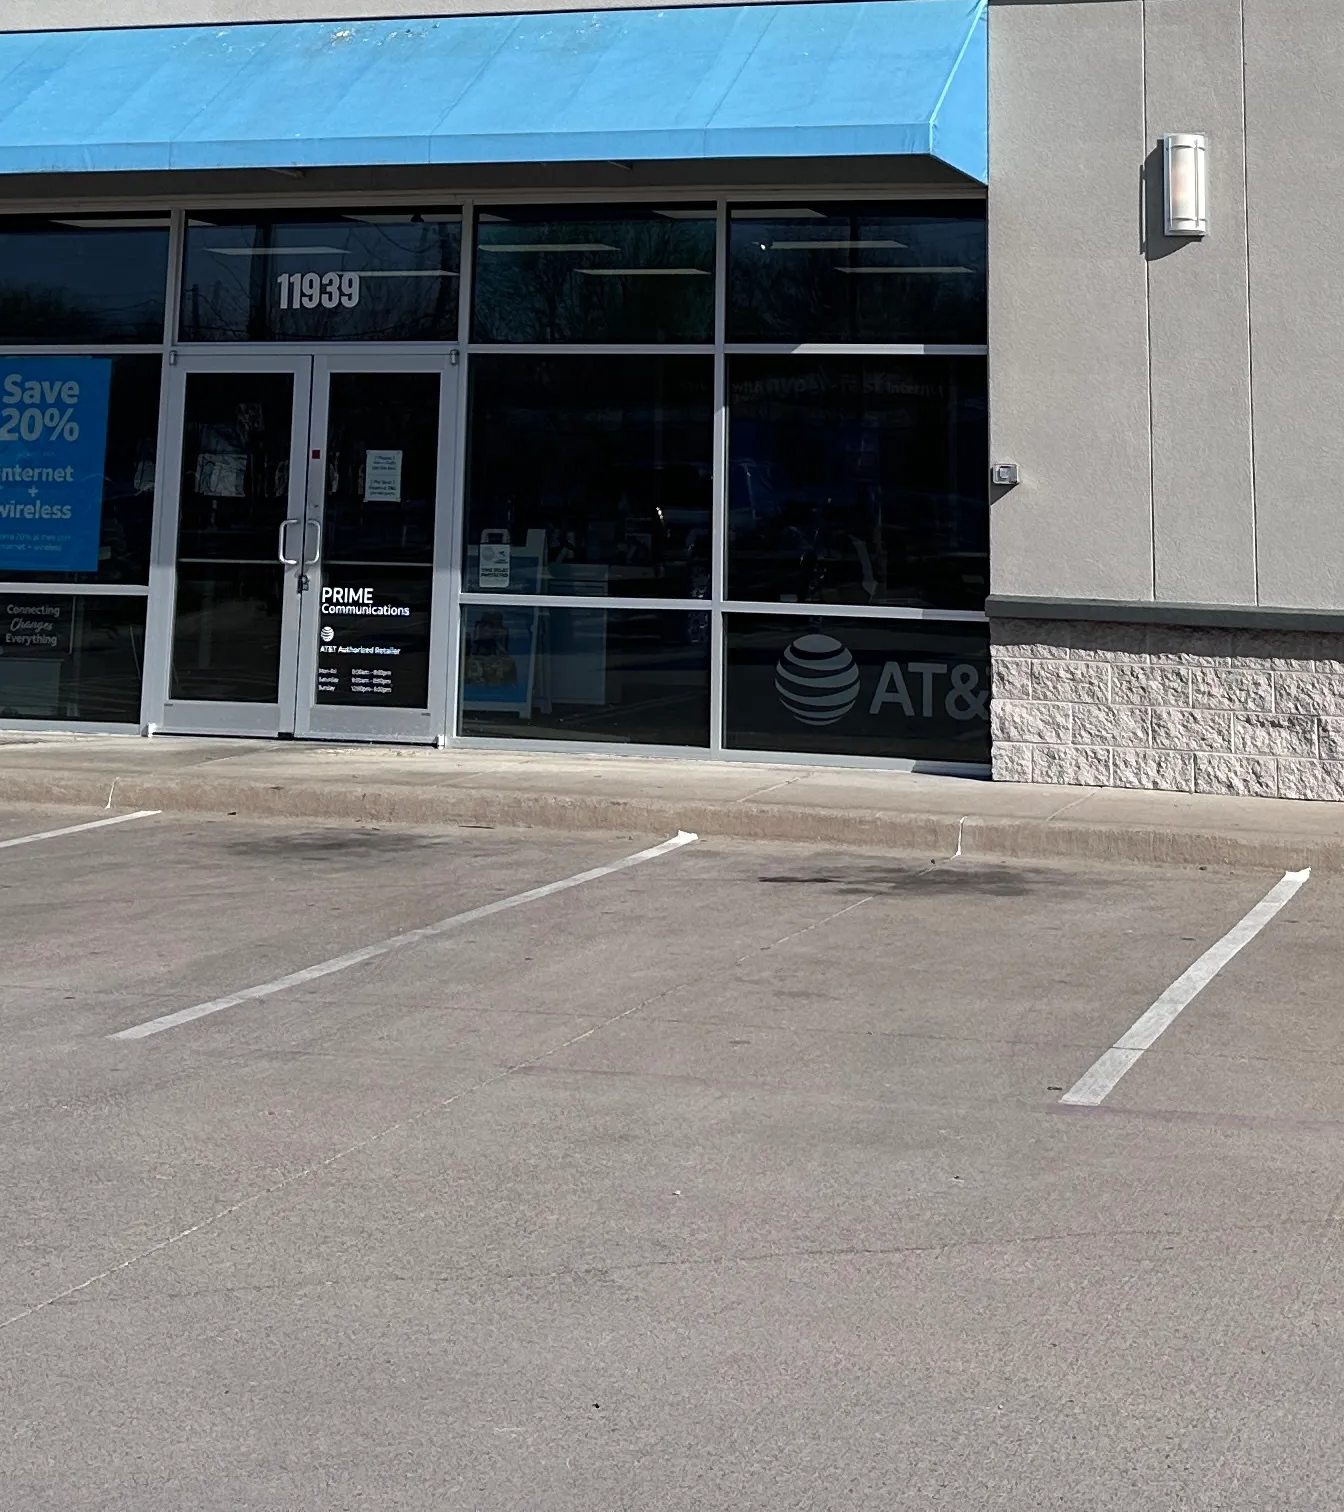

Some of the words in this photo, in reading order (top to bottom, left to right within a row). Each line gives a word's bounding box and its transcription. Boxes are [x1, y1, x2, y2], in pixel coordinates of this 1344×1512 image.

[277, 271, 360, 309] 11939
[2, 374, 80, 404] Save
[321, 587, 374, 603] PRIME
[7, 604, 60, 617] Connecting
[321, 603, 410, 616] Communications
[9, 617, 54, 632] Changes
[5, 632, 57, 646] Everything
[869, 661, 992, 721] AT&
